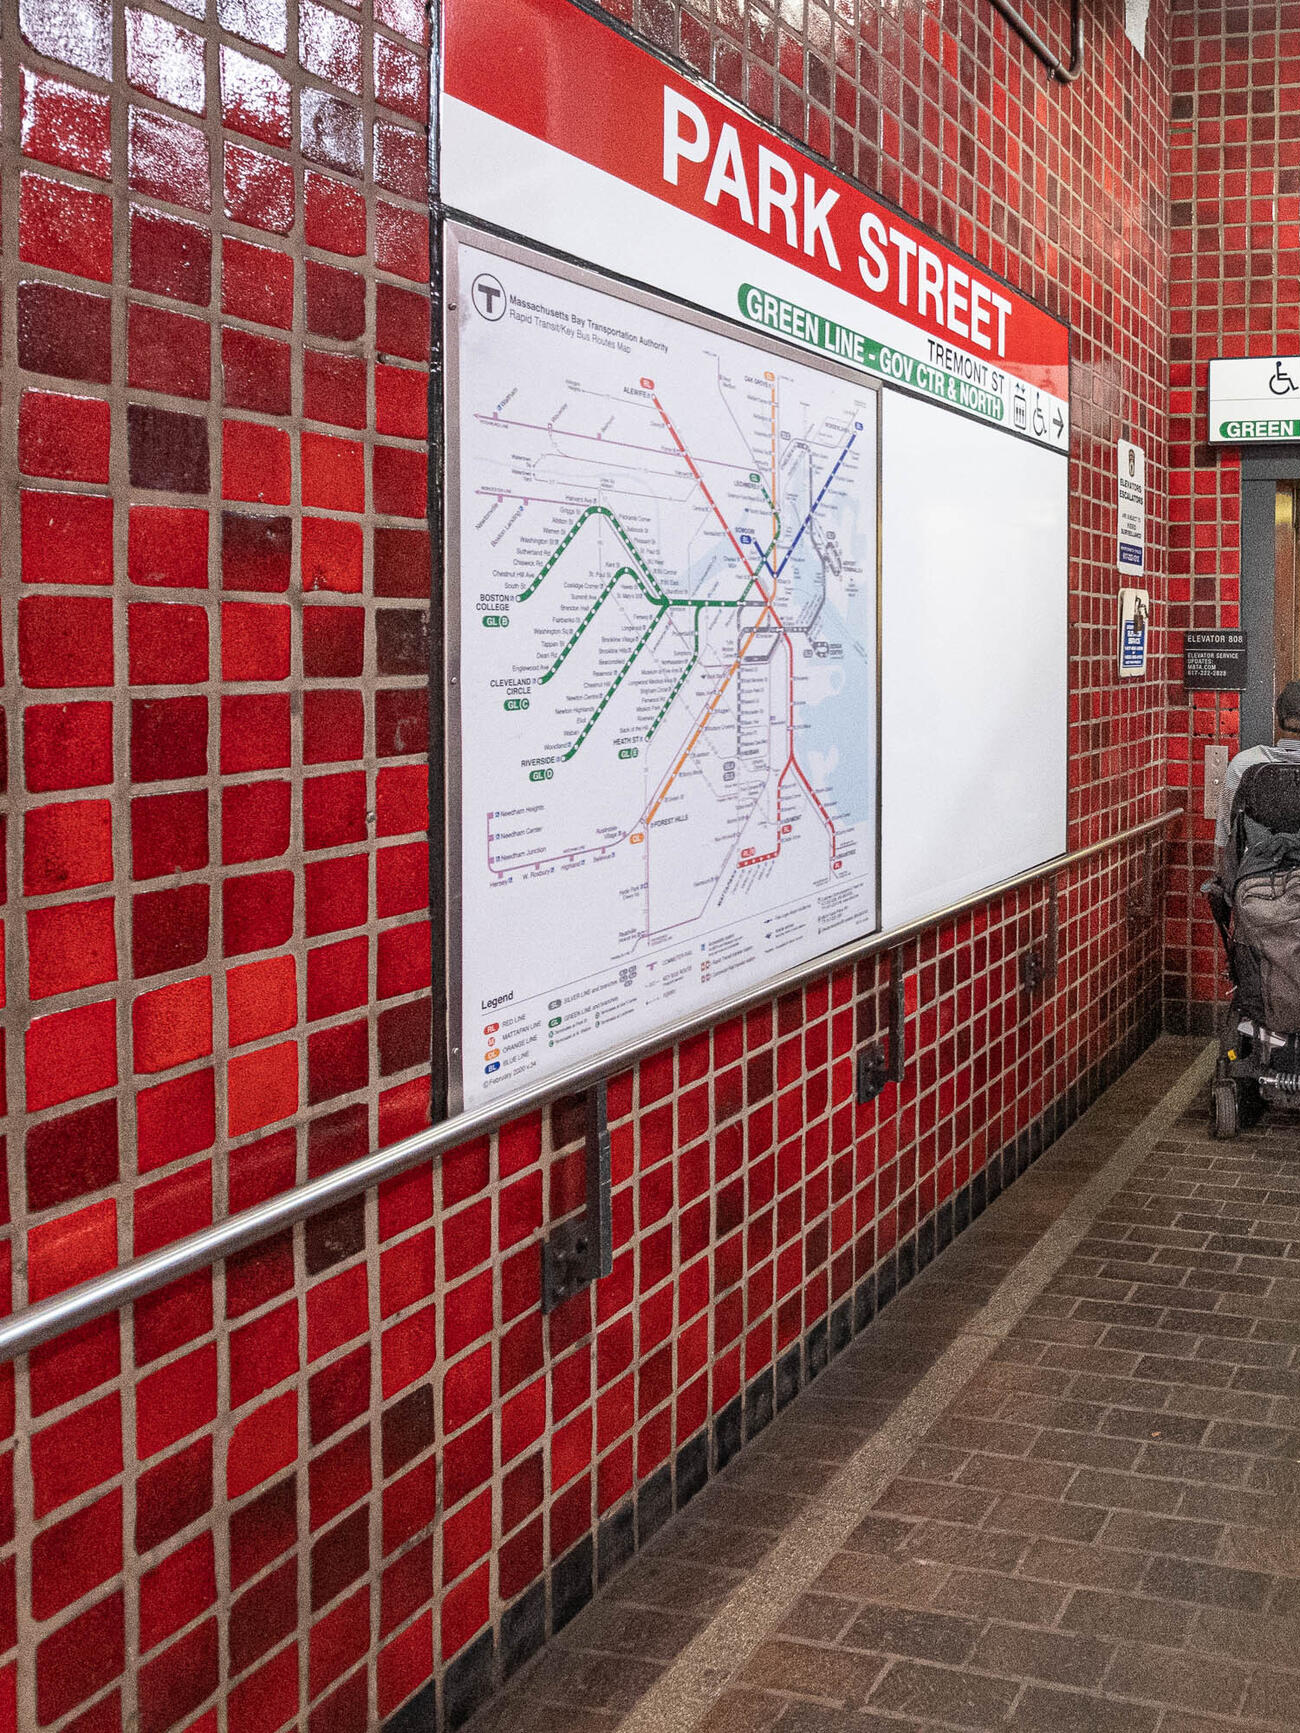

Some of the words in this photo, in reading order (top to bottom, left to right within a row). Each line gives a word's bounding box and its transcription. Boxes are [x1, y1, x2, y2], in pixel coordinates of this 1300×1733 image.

[663, 85, 841, 271] PARK
[858, 212, 1012, 358] STREET
[478, 283, 500, 314] T
[509, 294, 569, 322] Massachusetts
[571, 314, 586, 326] Bay
[587, 319, 638, 343] Transportation
[639, 336, 669, 353] Authority
[509, 309, 533, 324] Rapid
[534, 316, 575, 338] Transit/Key
[576, 329, 590, 341] Bus
[592, 333, 616, 349] Routes
[617, 342, 631, 354] Map
[747, 288, 818, 344] GREEN
[825, 322, 864, 362] LINE
[880, 348, 913, 382] GOV
[917, 364, 944, 397] CTR
[948, 379, 956, 401] &
[960, 382, 1000, 419] NORTH
[928, 339, 989, 384] TREMONT
[992, 371, 1004, 394] ST
[1227, 422, 1293, 437] GREEN
[1120, 478, 1142, 493] ELEVATORS
[1120, 490, 1143, 505] ESCALATORS
[504, 582, 520, 590] South
[480, 594, 510, 602] BOSTON
[475, 603, 510, 611] COLLEGE
[486, 617, 498, 626] GL
[490, 677, 531, 688] CLEVELAND
[506, 686, 531, 696] CIRCLE
[507, 700, 519, 710] GL
[521, 699, 528, 709] C
[613, 737, 631, 746] HEATH
[520, 756, 555, 768] RIVERSIDE
[532, 771, 544, 781] GL
[500, 808, 526, 818] Needham
[500, 830, 526, 840] Needham
[500, 851, 526, 862] Needham
[481, 990, 514, 1011] Legend
[487, 1024, 496, 1034] RL
[502, 1018, 514, 1028] RED
[514, 1013, 527, 1023] LINE
[502, 1025, 531, 1041] MATTAPAN
[531, 1020, 542, 1031] LINE
[488, 1049, 497, 1061] OL
[502, 1040, 526, 1054] ORANGE
[526, 1034, 538, 1045] LINE
[488, 1063, 498, 1073] BL
[502, 1055, 517, 1067] BLUE
[517, 1050, 530, 1061] LINE
[488, 1070, 512, 1085] February
